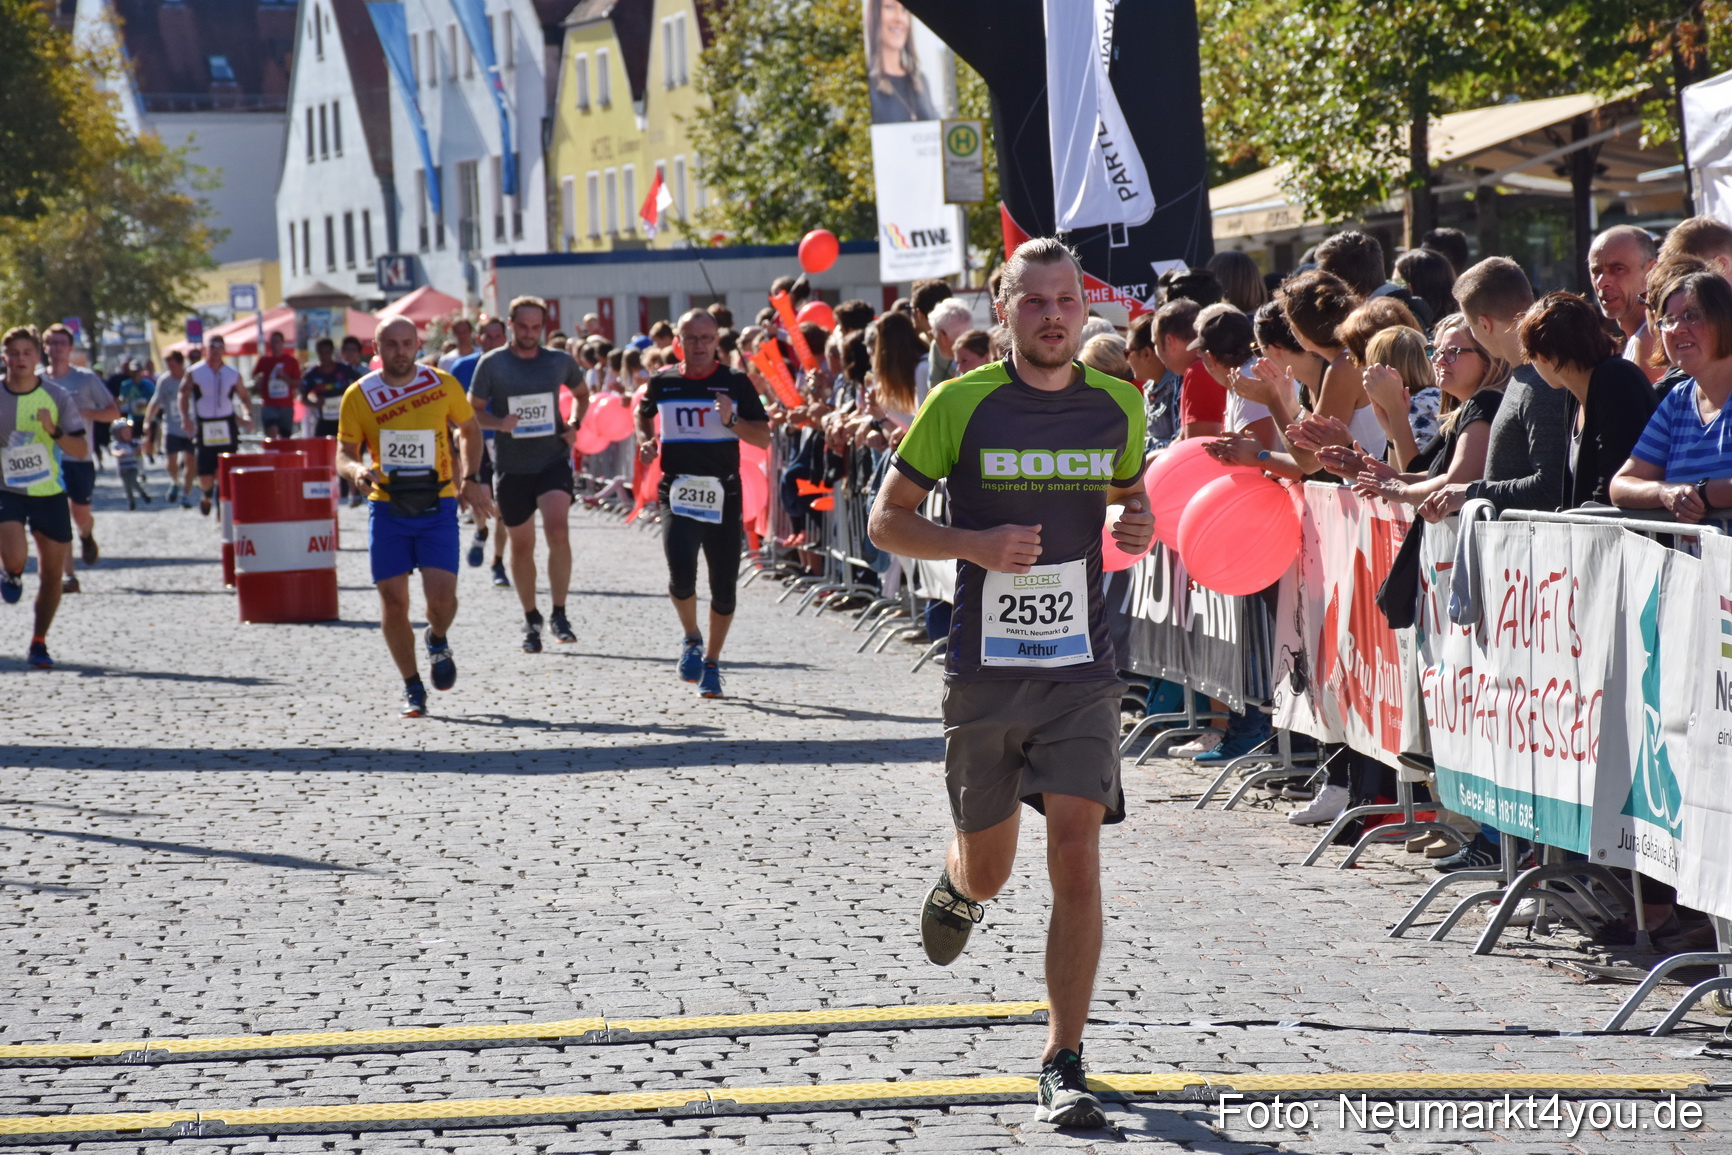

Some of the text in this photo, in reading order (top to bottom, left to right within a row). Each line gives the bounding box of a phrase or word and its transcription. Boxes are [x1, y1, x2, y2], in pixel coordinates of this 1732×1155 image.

[1097, 121, 1139, 202] PARTL
[1084, 283, 1148, 302] THE NEXT
[375, 389, 447, 426] MAX BÖGL
[516, 405, 547, 420] 2597
[675, 406, 711, 428] mr
[388, 442, 424, 459] 2421
[8, 454, 42, 471] 3083
[981, 449, 1116, 479] BOCK
[678, 487, 716, 504] 2318
[981, 481, 1027, 492] inspired
[1031, 482, 1044, 493] by
[1047, 482, 1080, 492] smart
[1014, 573, 1061, 586] BOCK
[998, 590, 1074, 625] 2532
[1006, 627, 1060, 636] PARTL Neumarkt
[1017, 642, 1058, 657] Arthur
[1617, 827, 1640, 853] Jura
